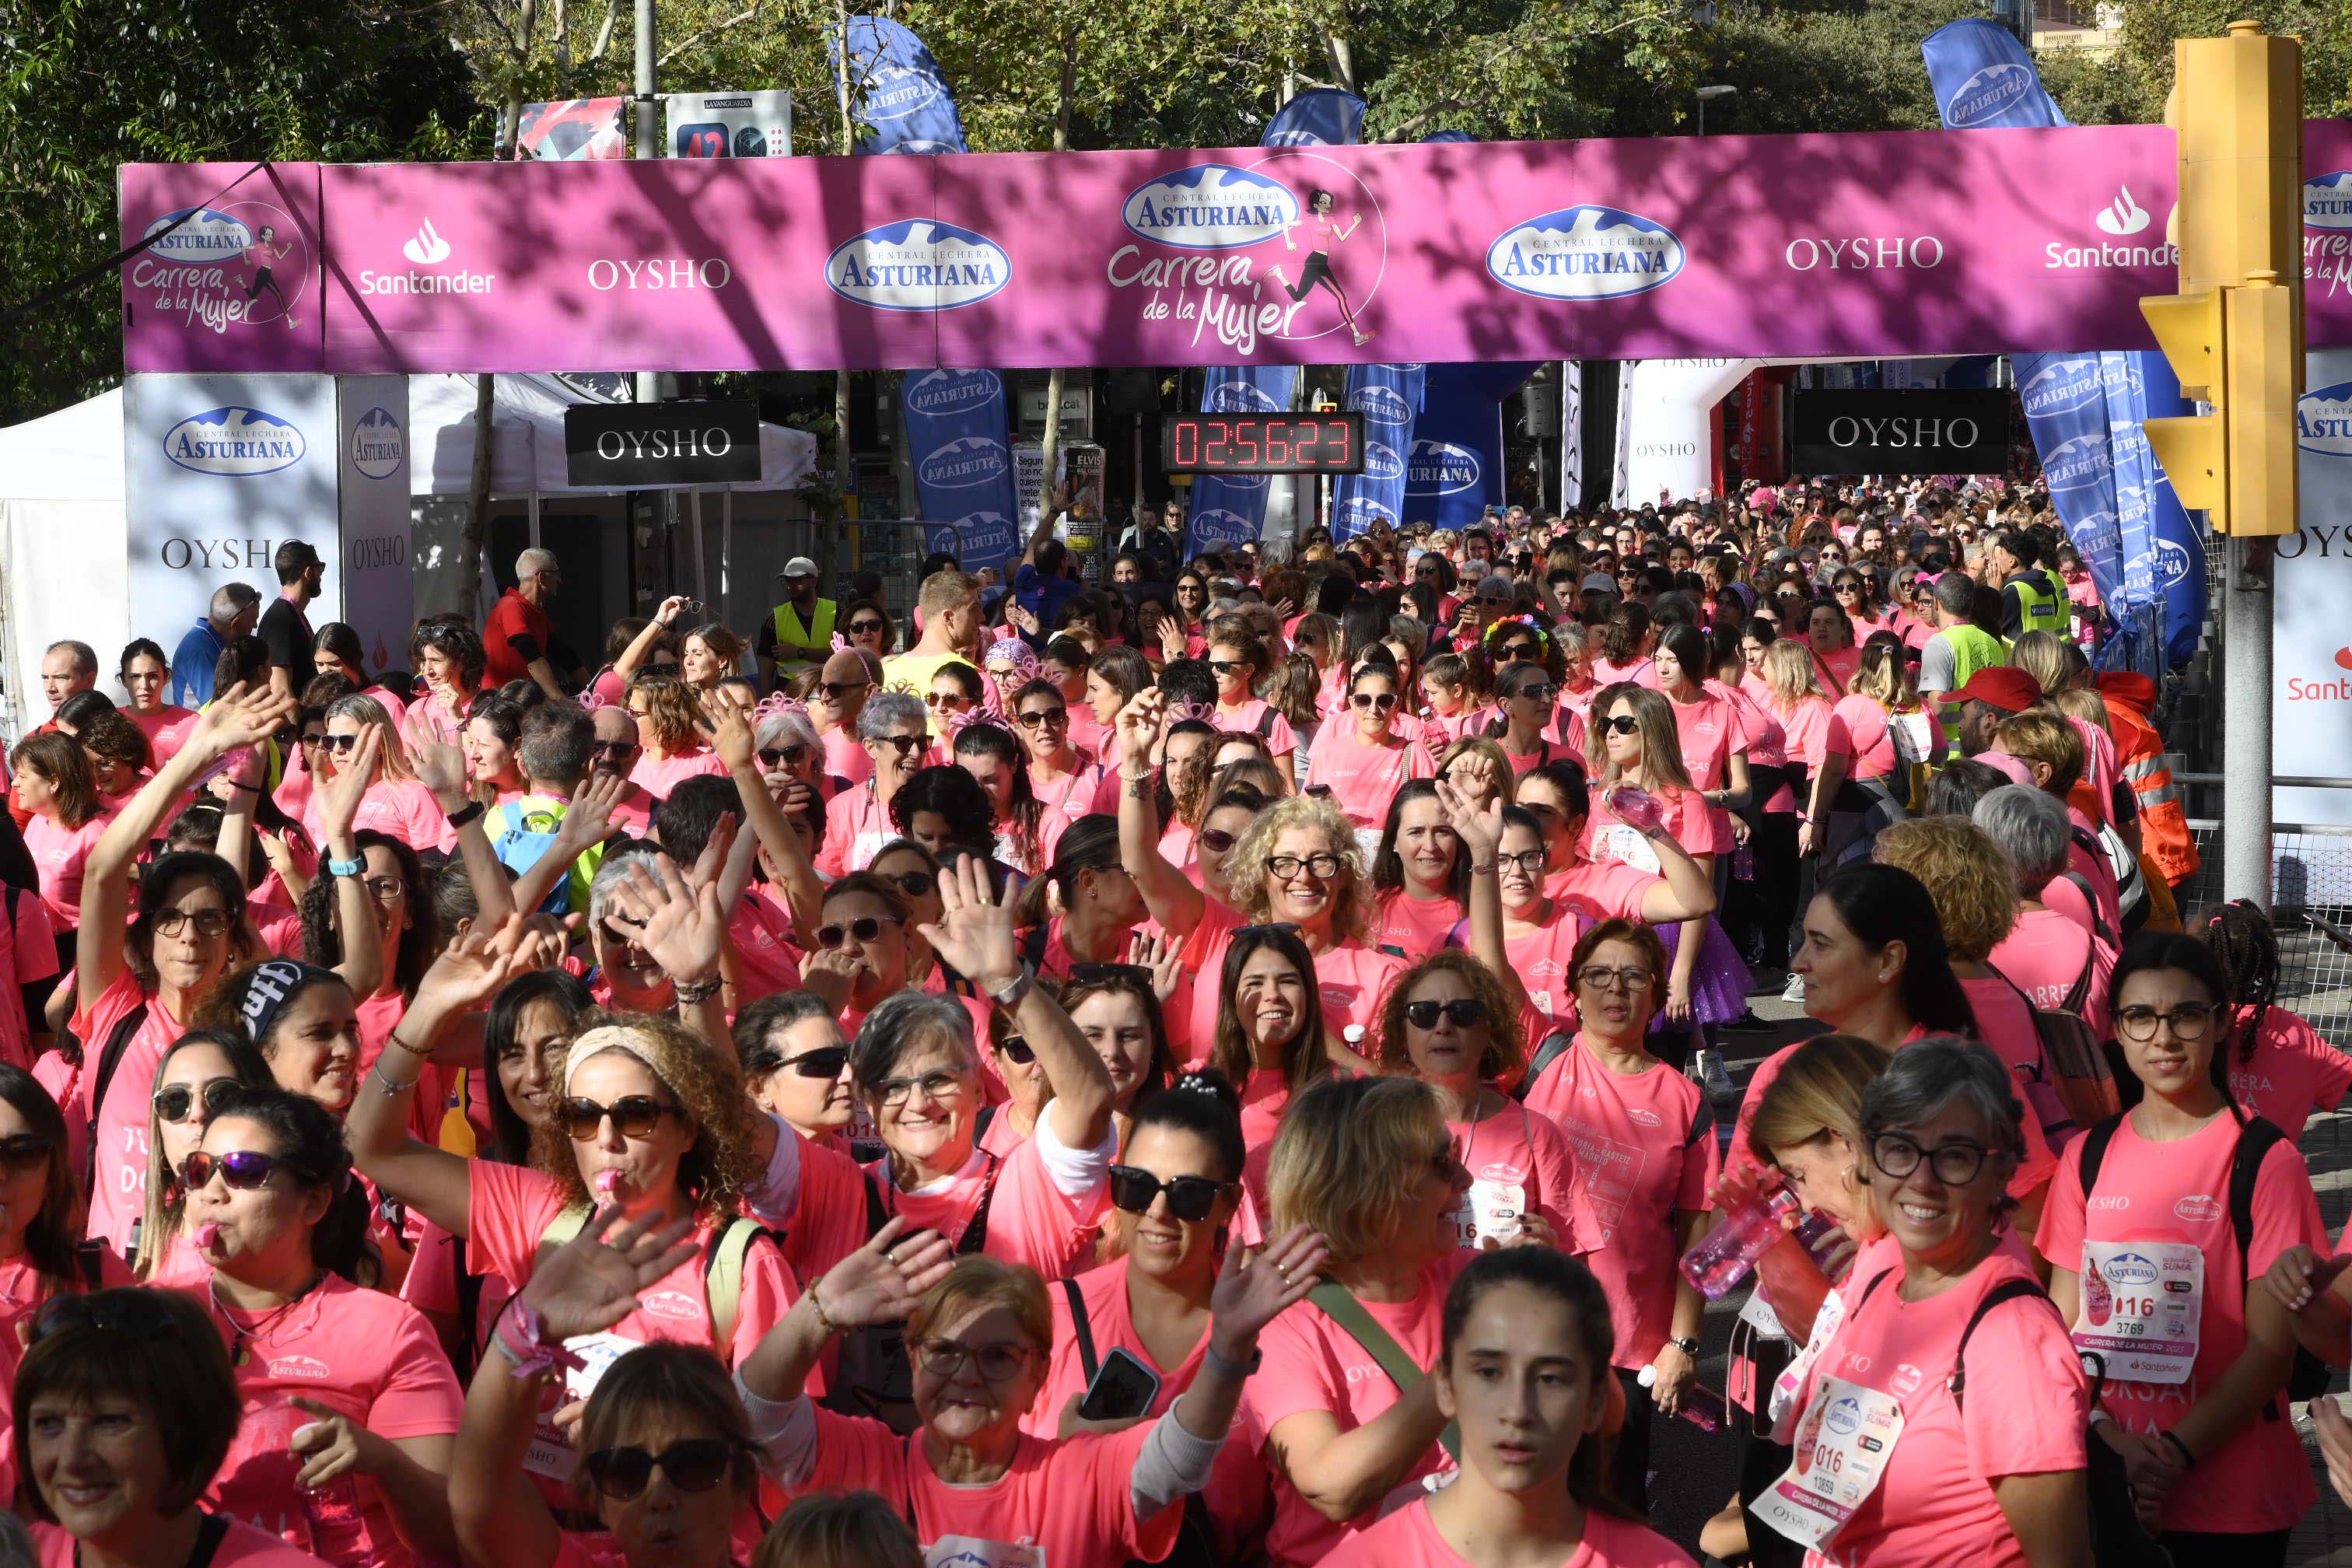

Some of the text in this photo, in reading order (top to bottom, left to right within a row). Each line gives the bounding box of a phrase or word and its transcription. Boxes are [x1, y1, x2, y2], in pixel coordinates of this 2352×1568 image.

[713, 100, 752, 108] VANGUARDIA
[1163, 192, 1281, 203] CENTRAL LECHERA
[1136, 197, 1285, 229] ASTURIANA
[151, 229, 243, 250] ASTURIANA
[1533, 237, 1663, 248] CENTRAL LECHERA
[868, 250, 990, 260] CENTRAL LECHERA
[1503, 242, 1670, 277] ASTURIANA
[1786, 236, 1944, 271] OYSHO
[2046, 242, 2179, 268] Santande
[133, 260, 223, 289] Carrera
[588, 258, 730, 290] OYSHO
[840, 254, 996, 289] ASTURIANA
[1108, 245, 1252, 288] Carrera
[2318, 257, 2331, 279] la
[360, 270, 495, 296] Santander
[156, 287, 259, 334] de la Mujer
[1143, 282, 1307, 355] de la Mujer
[1352, 395, 1406, 421] ASTURIANA
[1829, 416, 1979, 448] OYSHO
[174, 432, 296, 459] ASTURIANA
[355, 437, 401, 462] ASTURIANA
[597, 427, 731, 460] OYSHO
[1175, 422, 1349, 464] 02:56:23
[1637, 443, 1696, 457] OYSHO
[1077, 455, 1101, 465] ELVIS
[1409, 468, 1472, 482] URIANA
[161, 538, 306, 569] OYSH
[352, 535, 405, 570] OYSHO
[1086, 555, 1095, 565] 30
[2288, 677, 2352, 702] Sant
[2230, 1072, 2273, 1091] RERA
[1567, 1134, 1595, 1153] VITORIA
[1579, 1148, 1609, 1166] MADRID
[1457, 1223, 1477, 1239] 16
[2109, 1266, 2154, 1279] ASTURIANA
[2162, 1262, 2192, 1271] SUMA
[1756, 1310, 1783, 1332] OYSH
[2116, 1322, 2144, 1335] 3769
[2137, 1342, 2164, 1352] MUJER
[269, 1362, 324, 1377] ASTURIANA
[1346, 1363, 1383, 1382] OYS
[2141, 1361, 2183, 1373] Santander
[1866, 1415, 1893, 1430] SUMA
[527, 1447, 557, 1466] SHO
[1815, 1444, 1844, 1473] 016
[1813, 1475, 1834, 1496] 13859
